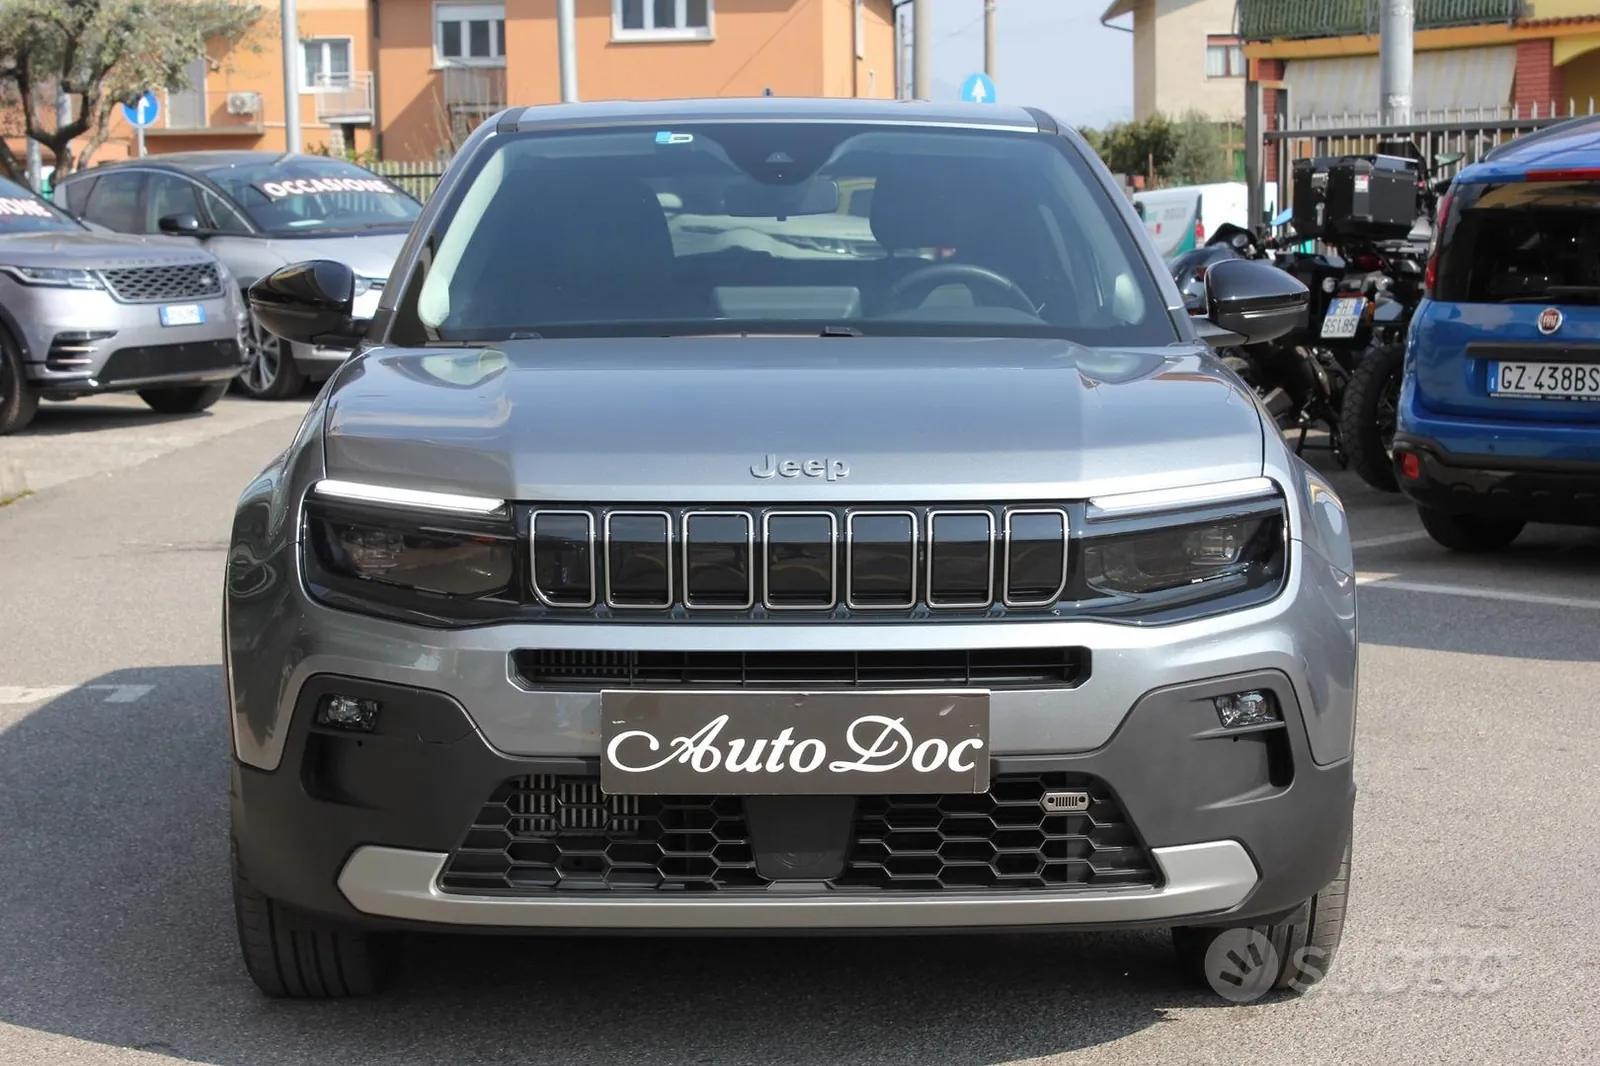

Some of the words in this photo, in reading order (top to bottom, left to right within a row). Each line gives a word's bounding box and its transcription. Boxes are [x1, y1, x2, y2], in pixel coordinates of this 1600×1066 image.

[264, 178, 395, 197] OCCASIONE
[749, 452, 850, 482] Jeep
[607, 714, 826, 773] Auto
[828, 714, 984, 773] Doc
